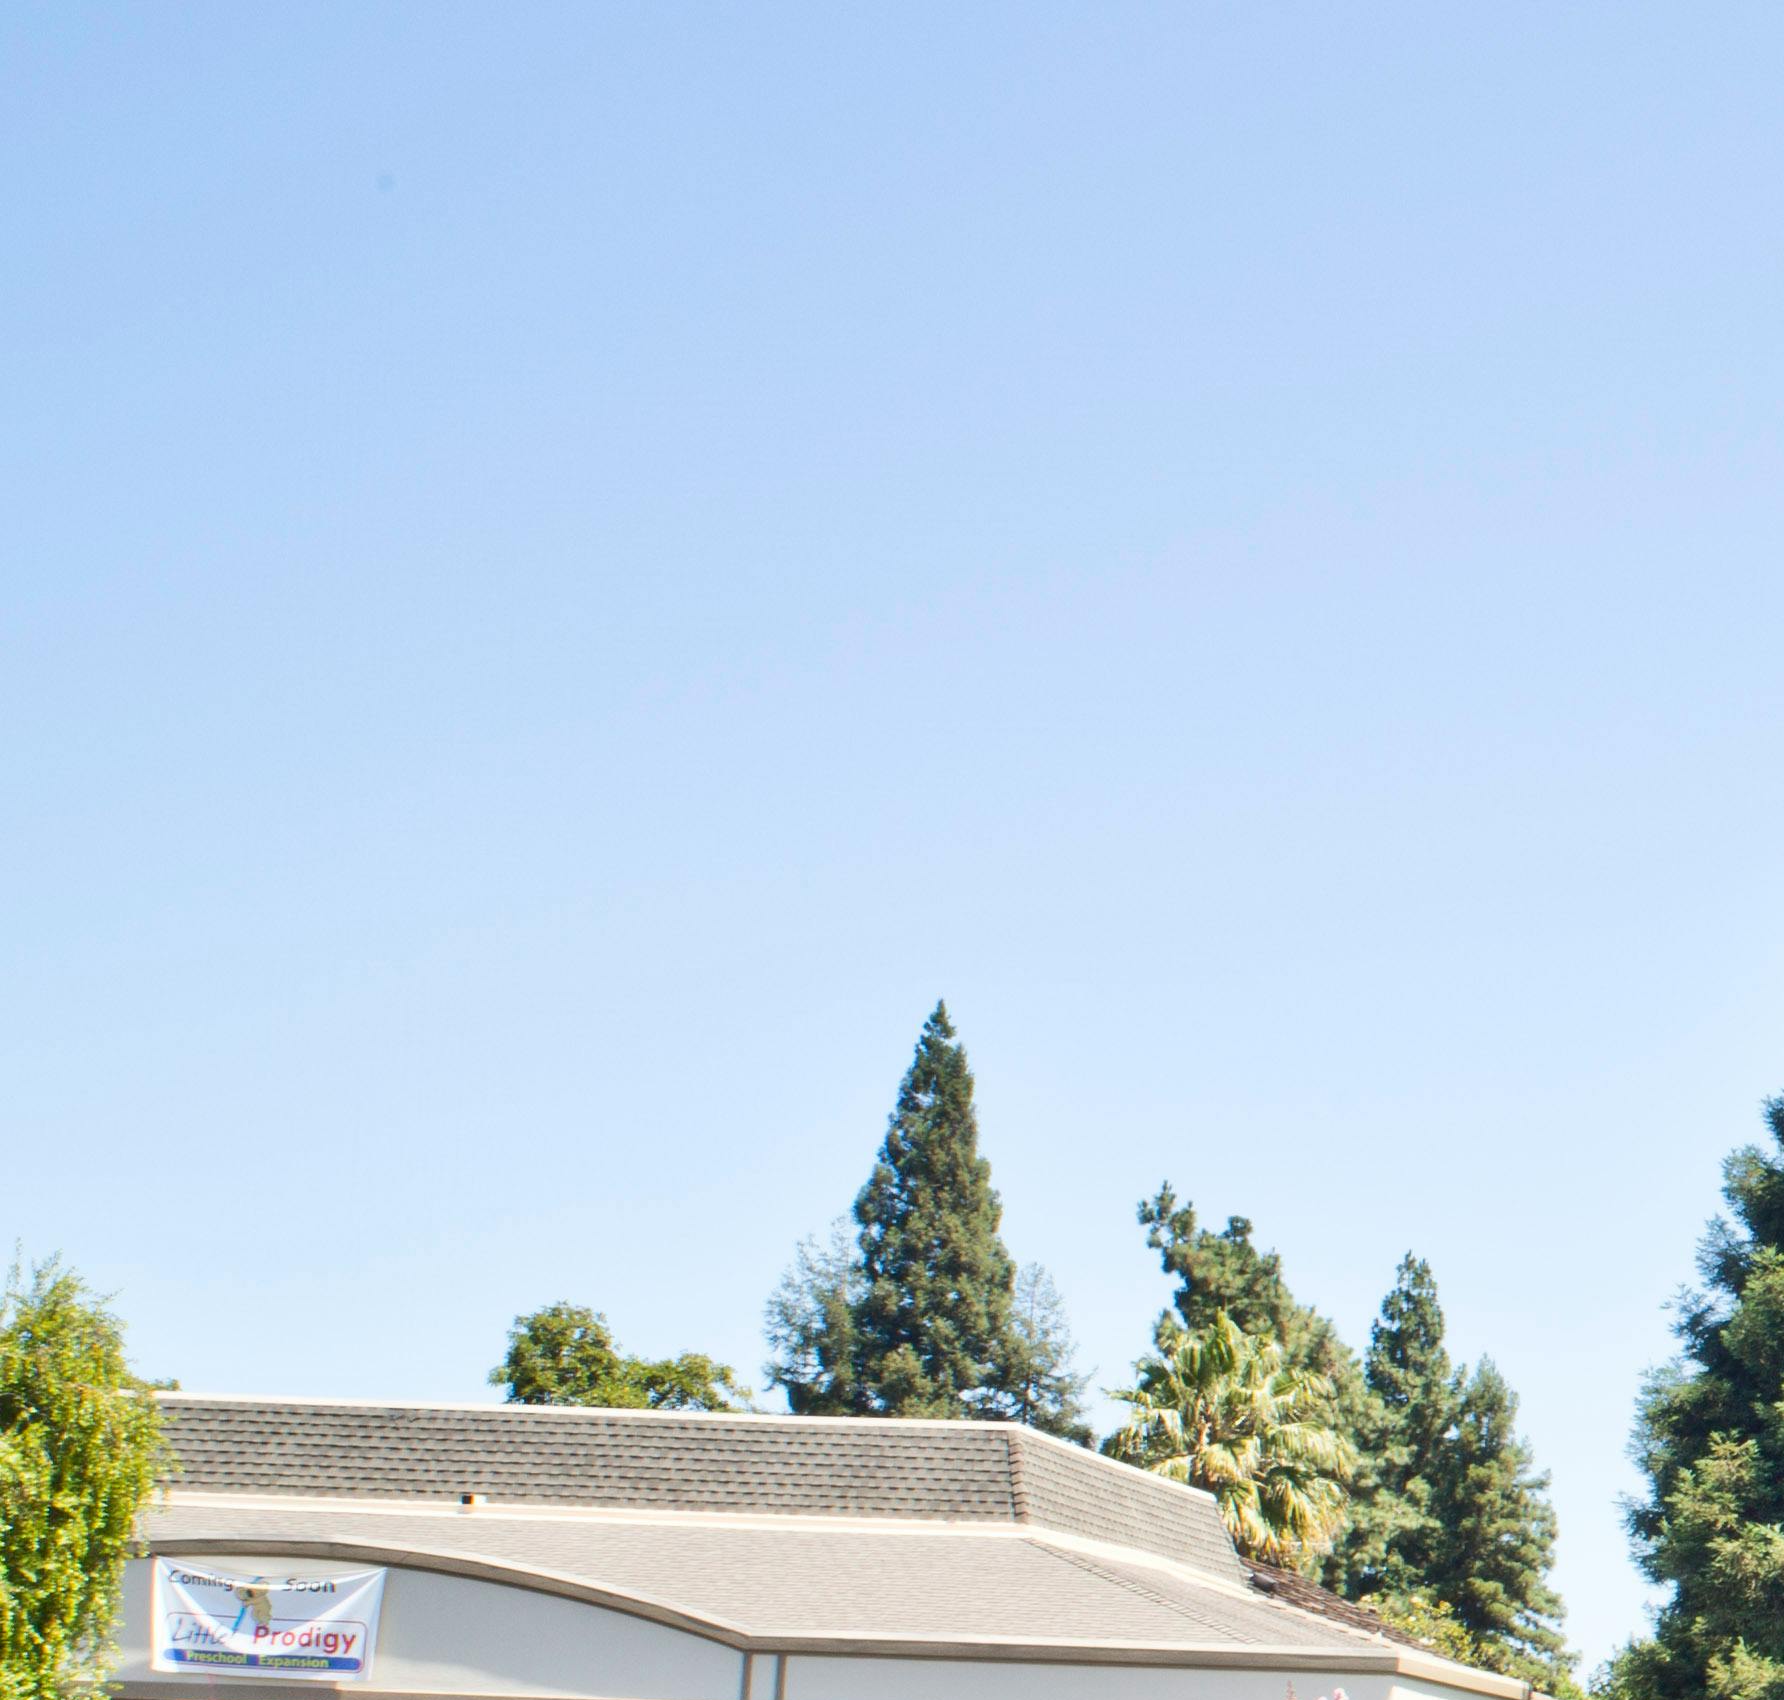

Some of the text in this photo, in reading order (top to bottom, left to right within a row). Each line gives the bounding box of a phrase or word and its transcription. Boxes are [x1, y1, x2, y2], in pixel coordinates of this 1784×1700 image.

[168, 1569, 337, 1593] Coming Soon
[252, 1624, 356, 1655] Prodigy
[187, 1649, 330, 1668] Preschool Expansion
